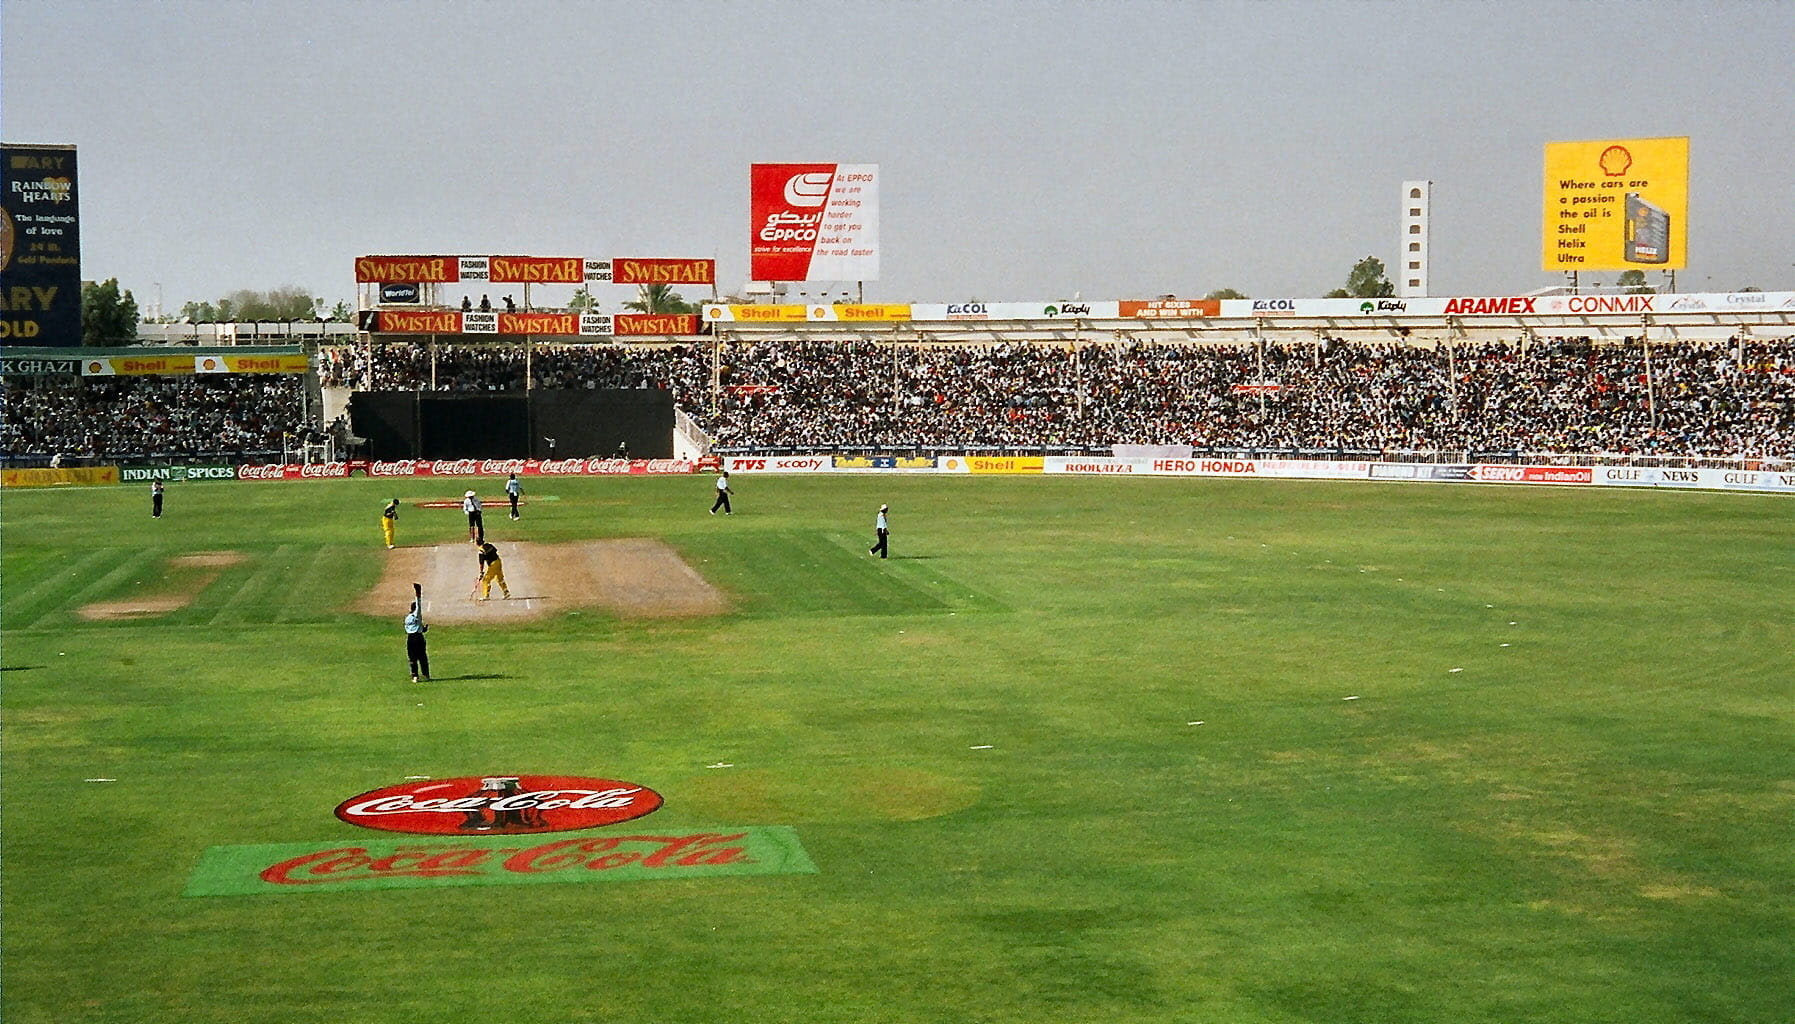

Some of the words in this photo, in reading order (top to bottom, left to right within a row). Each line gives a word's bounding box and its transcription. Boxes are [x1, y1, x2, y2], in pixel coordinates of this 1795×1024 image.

[847, 174, 874, 182] EPPCO
[11, 181, 72, 193] RAINBOW
[1560, 179, 1595, 189] Where
[1601, 180, 1623, 189] cars
[1629, 180, 1648, 188] are
[22, 191, 71, 203] HEARTS
[1572, 194, 1615, 205] passion
[831, 199, 861, 208] working
[827, 211, 853, 219] harder
[1560, 209, 1578, 219] the
[1583, 208, 1597, 218] oil
[1602, 208, 1611, 218] is
[15, 214, 32, 222] The
[35, 214, 76, 224] language
[25, 227, 37, 235] of
[41, 226, 63, 235] love
[1558, 224, 1586, 234] Shell
[820, 236, 839, 244] back
[1558, 239, 1585, 249] Helix
[831, 248, 848, 256] road
[1558, 253, 1585, 263] Ultra
[460, 260, 487, 269] FASHION
[585, 261, 611, 270] FASHION
[358, 258, 447, 282] SWISTAR
[493, 258, 580, 282] SWISTAR
[623, 260, 710, 283] SWISTAR
[460, 271, 489, 280] WATCHES
[584, 272, 612, 281] WATCHES
[1568, 296, 1654, 312] CONMIX
[1726, 294, 1765, 304] Crystal
[1443, 297, 1537, 314] ARAMEX
[741, 308, 780, 318] Shell
[845, 307, 884, 317] Shell
[384, 313, 458, 332] SWISTAR
[465, 314, 495, 323] FASHION
[503, 314, 575, 333] SWISTAR
[582, 316, 611, 324] FASHION
[464, 323, 496, 332] WATCHES
[581, 325, 612, 333] WATCHES
[619, 315, 691, 334] SWISTAR
[18, 360, 74, 373] GHAZI
[123, 360, 166, 372] Shell
[237, 359, 280, 370] Shell
[733, 459, 767, 470] TVS
[776, 458, 823, 471] scooty
[974, 460, 1015, 470] Shell
[1153, 460, 1195, 472] HERO
[1201, 461, 1256, 473] HONDA
[123, 468, 170, 480] INDIAN
[187, 466, 234, 479] SPICES
[1482, 466, 1525, 480] SERVO
[1607, 469, 1641, 480] GULF
[1662, 470, 1699, 482] NEWS
[1724, 472, 1758, 484] GULF
